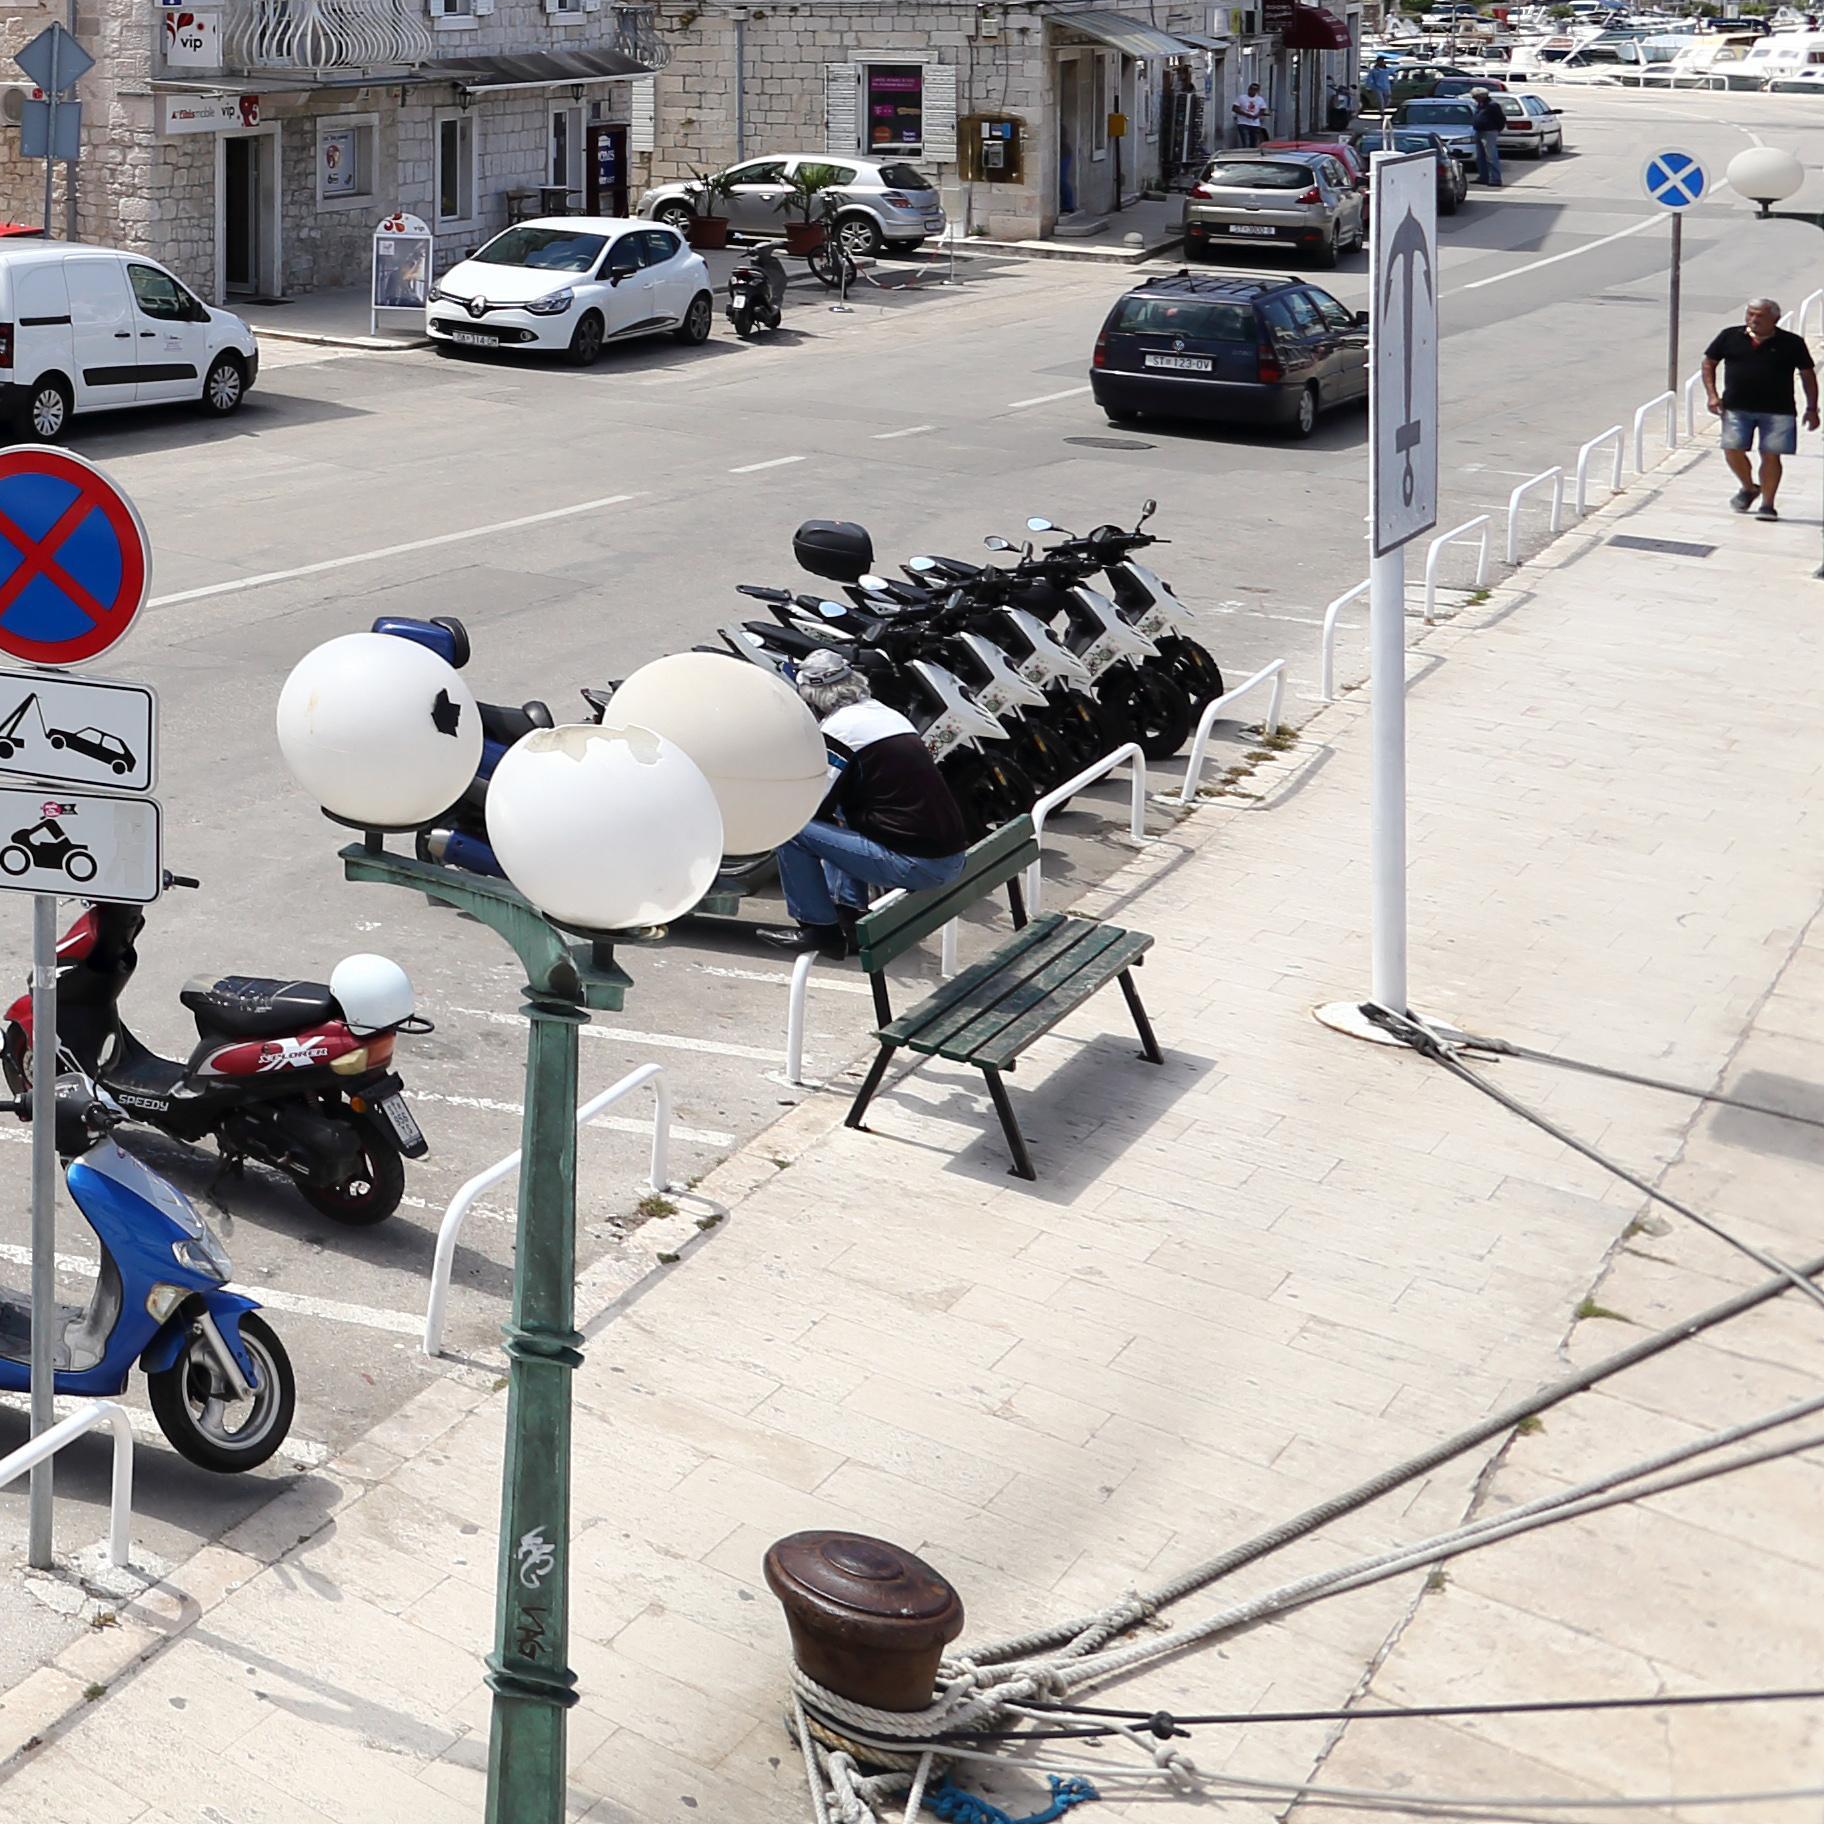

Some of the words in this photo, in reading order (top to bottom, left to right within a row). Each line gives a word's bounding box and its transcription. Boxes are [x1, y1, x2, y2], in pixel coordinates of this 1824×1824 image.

[180, 36, 203, 52] vip
[221, 107, 235, 120] vip
[1152, 356, 1164, 366] ST
[118, 1093, 170, 1112] SPEEDY
